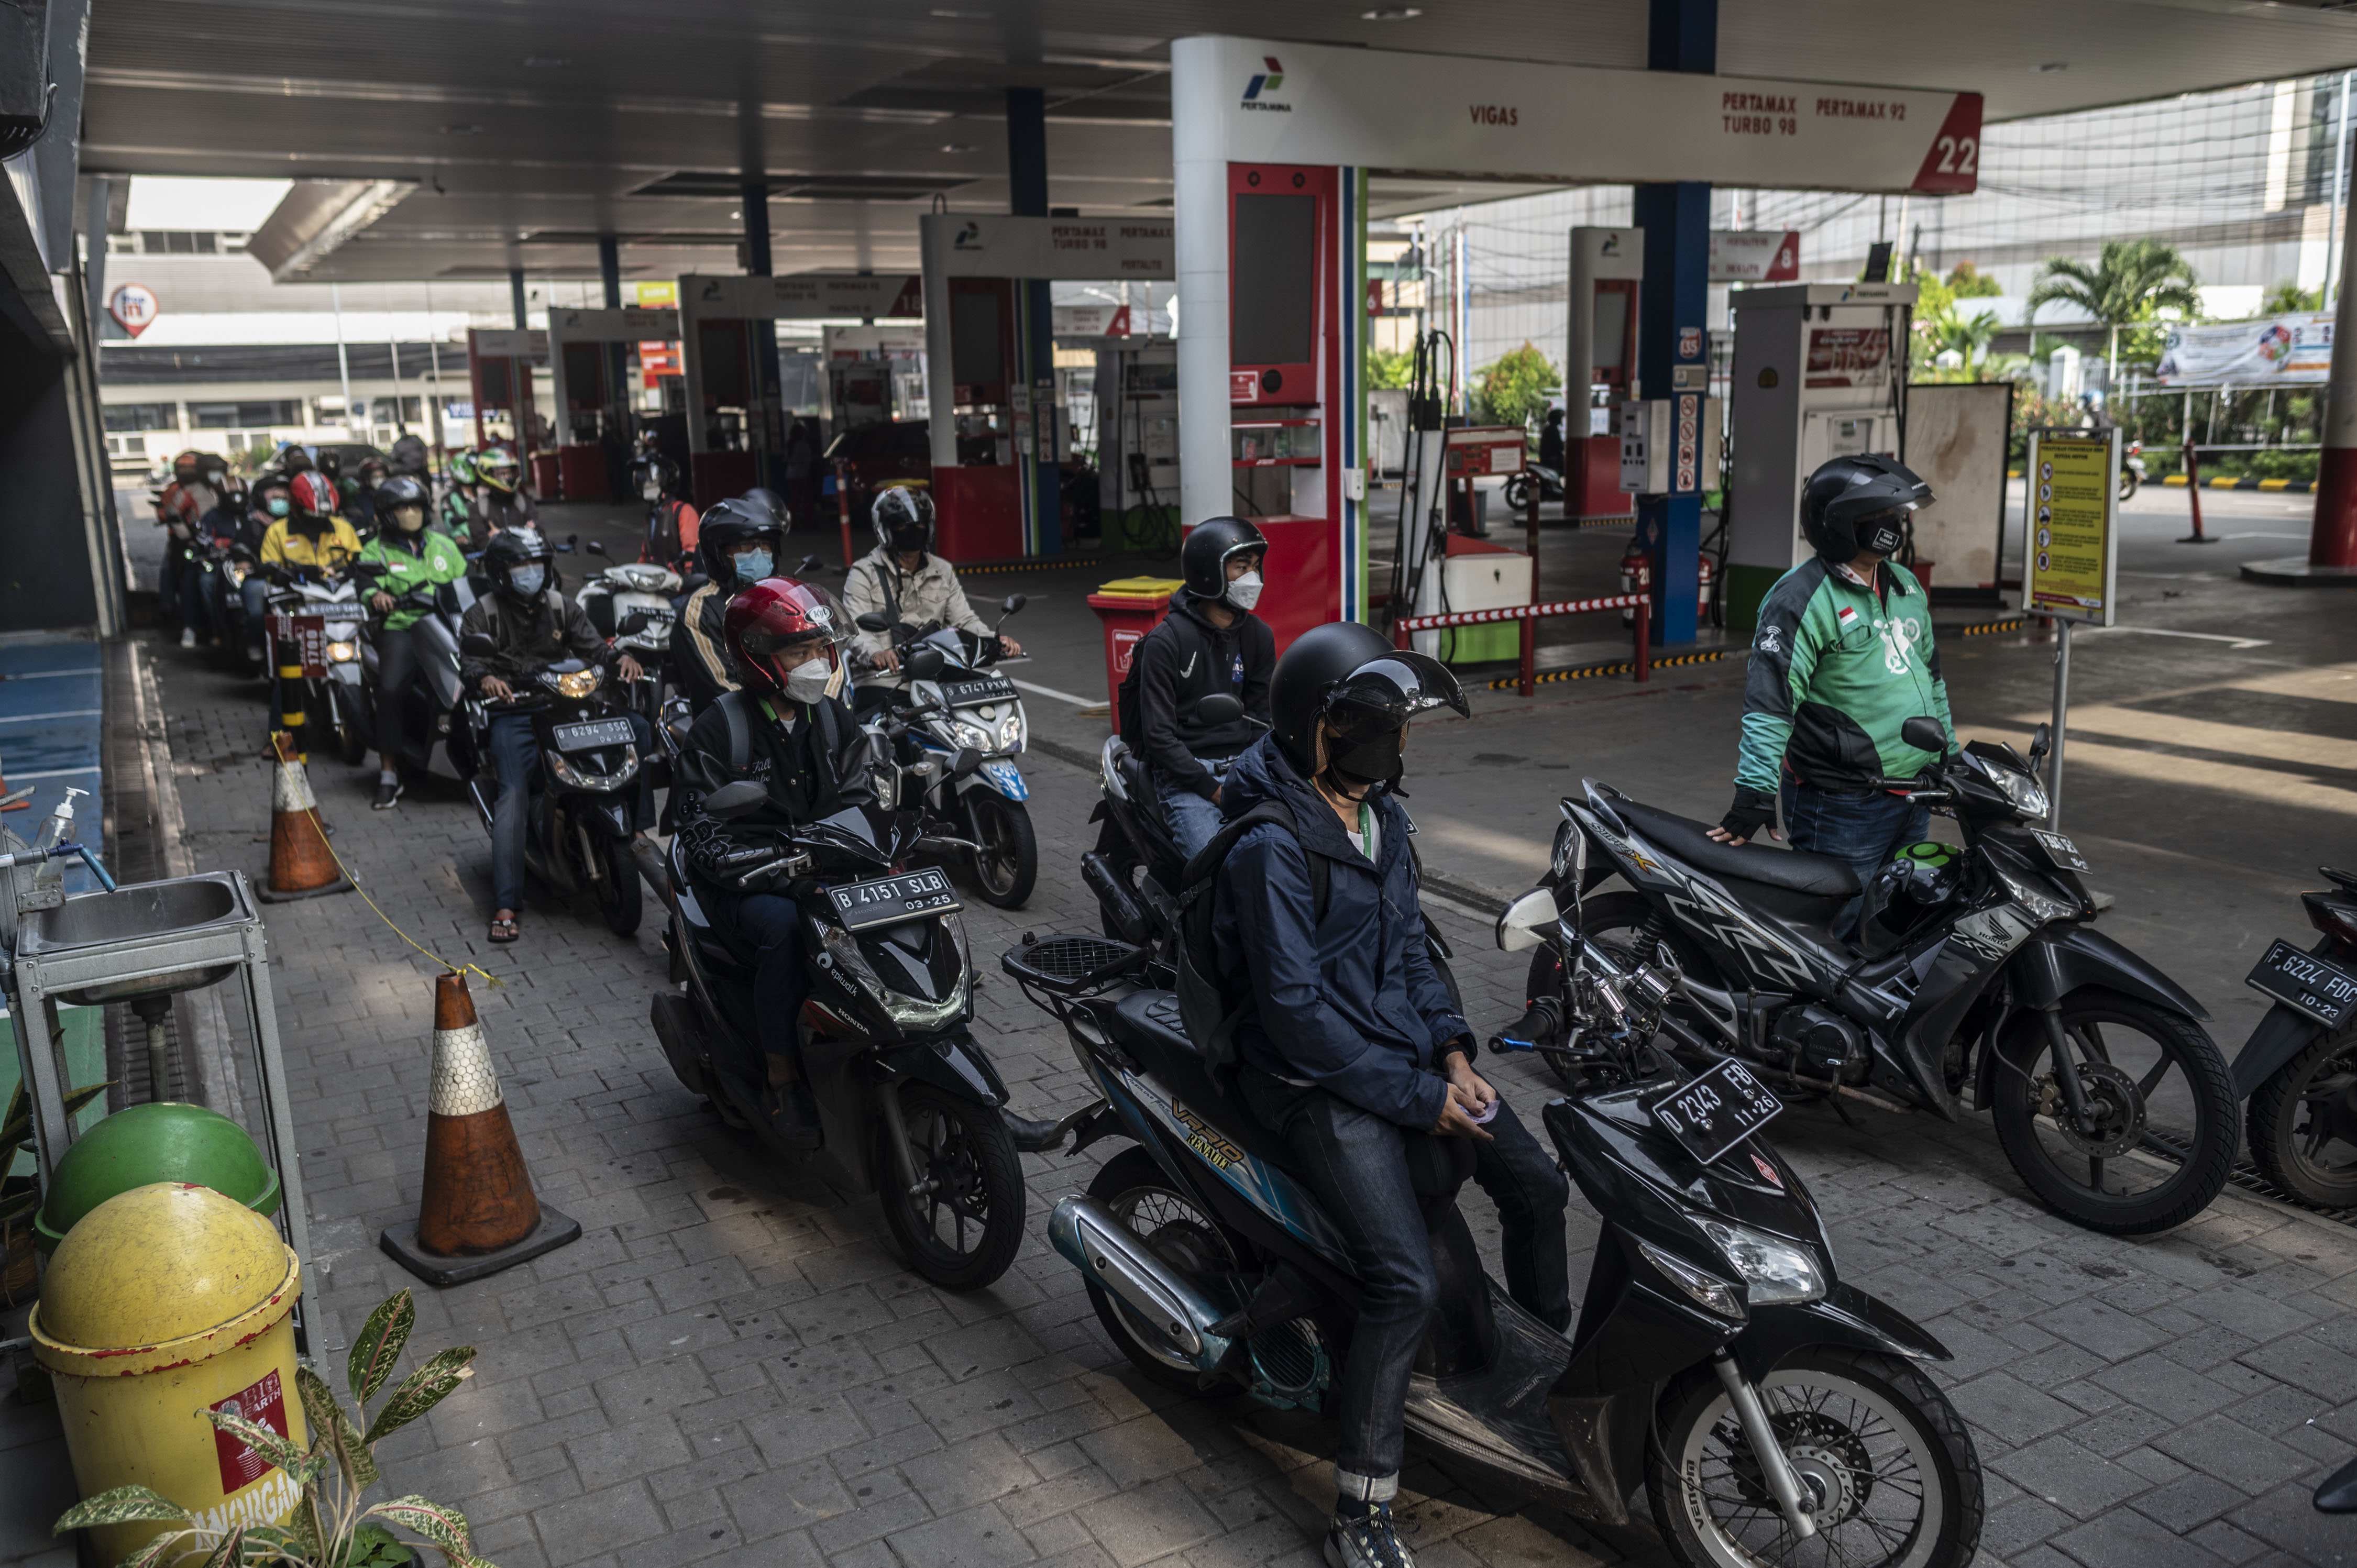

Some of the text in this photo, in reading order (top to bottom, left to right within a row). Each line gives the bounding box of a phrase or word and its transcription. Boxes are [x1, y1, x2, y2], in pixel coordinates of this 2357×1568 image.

[1241, 102, 1292, 112] PERTAMINA
[1722, 92, 1797, 114] PERTAMAX
[1816, 98, 1906, 121] PERTAMAX 92
[1469, 105, 1518, 126] VIGAS
[1722, 116, 1797, 136] TURBO 98
[1936, 136, 1976, 174] 22
[1052, 226, 1172, 238] PERTAMAX PERTAMAX
[1053, 239, 1088, 250] TURBO
[1781, 248, 1793, 269] 8
[902, 294, 921, 313] 18
[1116, 317, 1125, 330] 4
[1879, 536, 1893, 546] SUDAH
[946, 679, 1009, 697] B 6747 PXM
[557, 728, 565, 740] B
[571, 724, 599, 737] 6294
[838, 875, 943, 909] B 4151 SLB
[854, 905, 884, 915] HONDA
[1978, 931, 2009, 948] HONDA
[831, 968, 857, 997] epiwalk
[2267, 948, 2284, 963] F
[2282, 955, 2325, 985] 6224
[2323, 976, 2357, 1003] FDC
[838, 1007, 871, 1035] HONDA
[1810, 1043, 1841, 1055] HONDA
[1659, 1063, 1753, 1135] D 2343 FB
[1171, 1095, 1245, 1163] VARIO
[1185, 1132, 1231, 1173] RENAULT
[244, 1386, 282, 1419] EARTH
